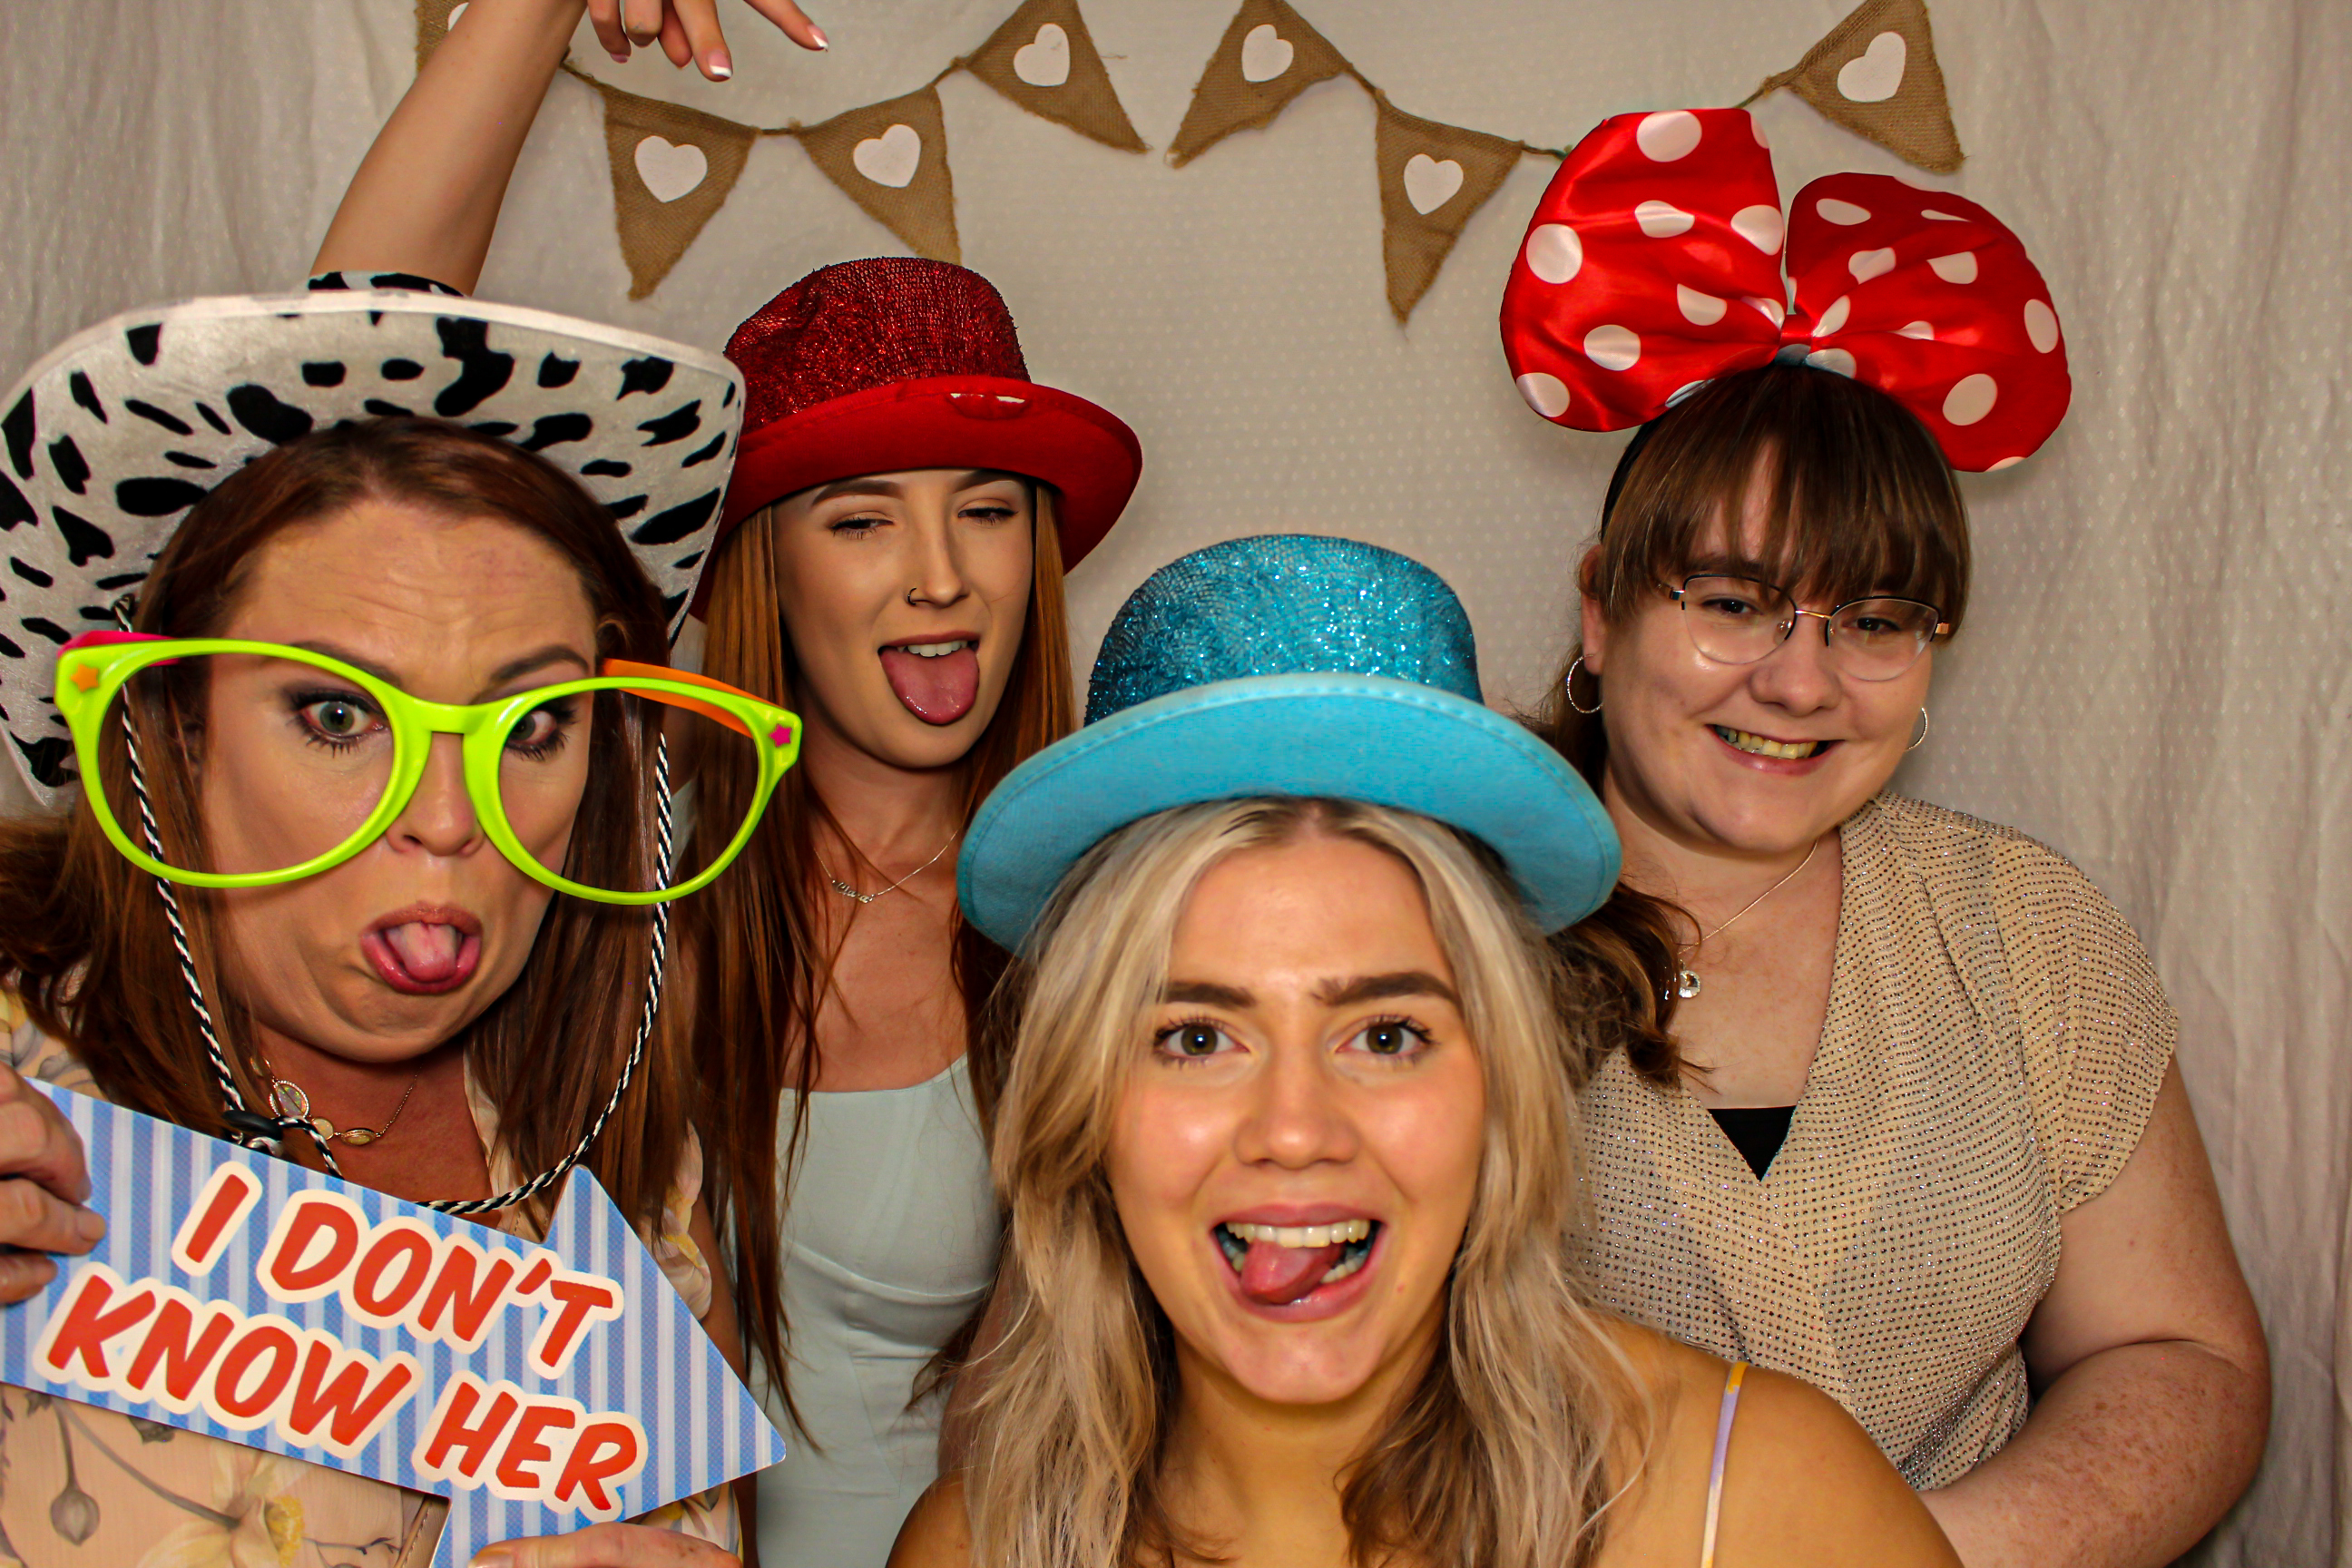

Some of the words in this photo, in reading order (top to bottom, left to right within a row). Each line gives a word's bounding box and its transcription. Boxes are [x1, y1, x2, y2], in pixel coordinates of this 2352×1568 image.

[186, 1174, 250, 1263] I
[270, 1201, 613, 1367] DON'T
[47, 1275, 413, 1446] KNOW
[424, 1381, 638, 1511] HER
